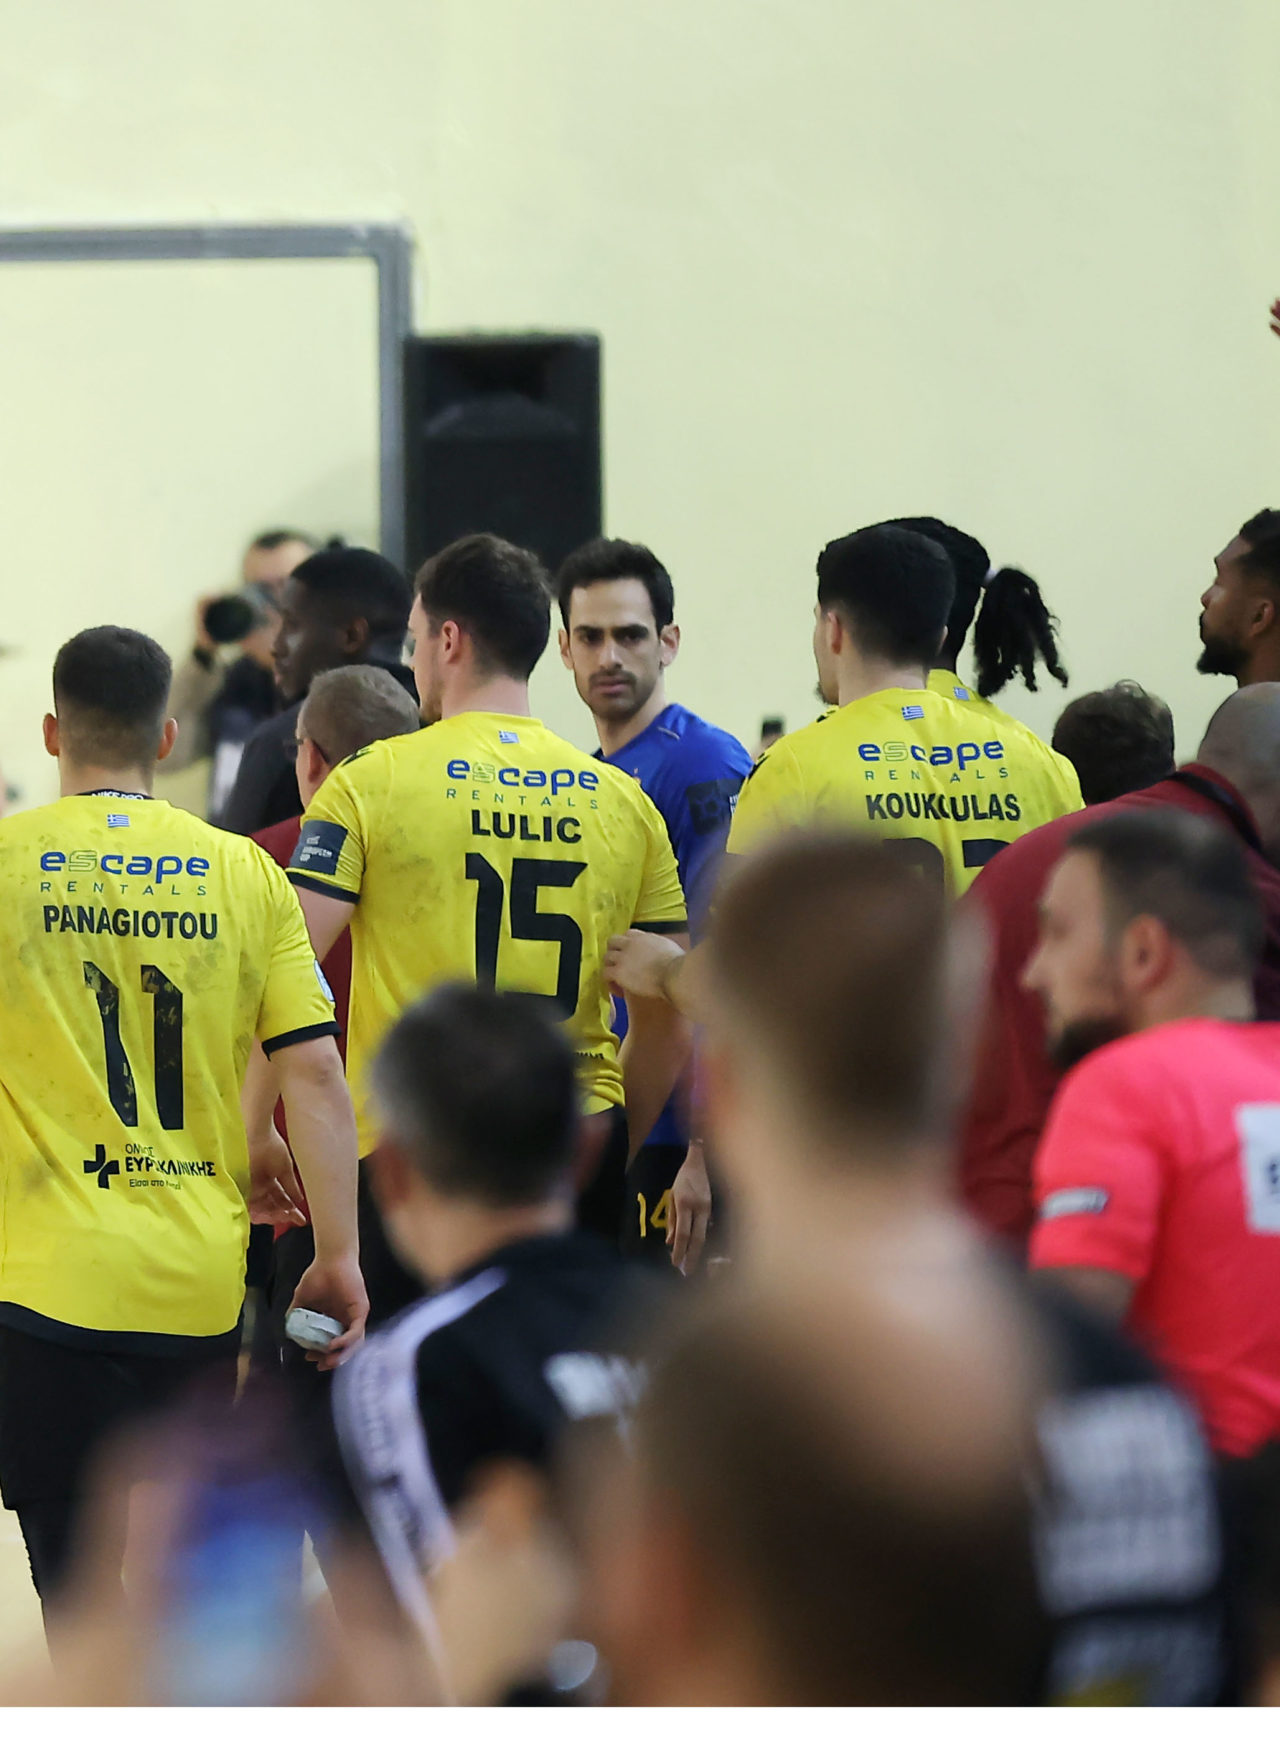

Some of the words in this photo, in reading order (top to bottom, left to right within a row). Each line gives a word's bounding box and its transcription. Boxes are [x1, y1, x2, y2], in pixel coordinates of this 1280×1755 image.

[858, 740, 1005, 771] escape
[447, 759, 600, 796] escape
[865, 767, 1009, 784] RENALS
[446, 788, 599, 810] RENTALS
[471, 809, 582, 844] LULIC
[40, 850, 210, 884] escape
[40, 880, 207, 896] RENTALS
[43, 904, 218, 940] PANAGIOTOU
[465, 852, 588, 1023] 15
[82, 960, 184, 1131] 11
[125, 1156, 217, 1177] ΕΥΡΚΛΙΝΙΚΗΣ
